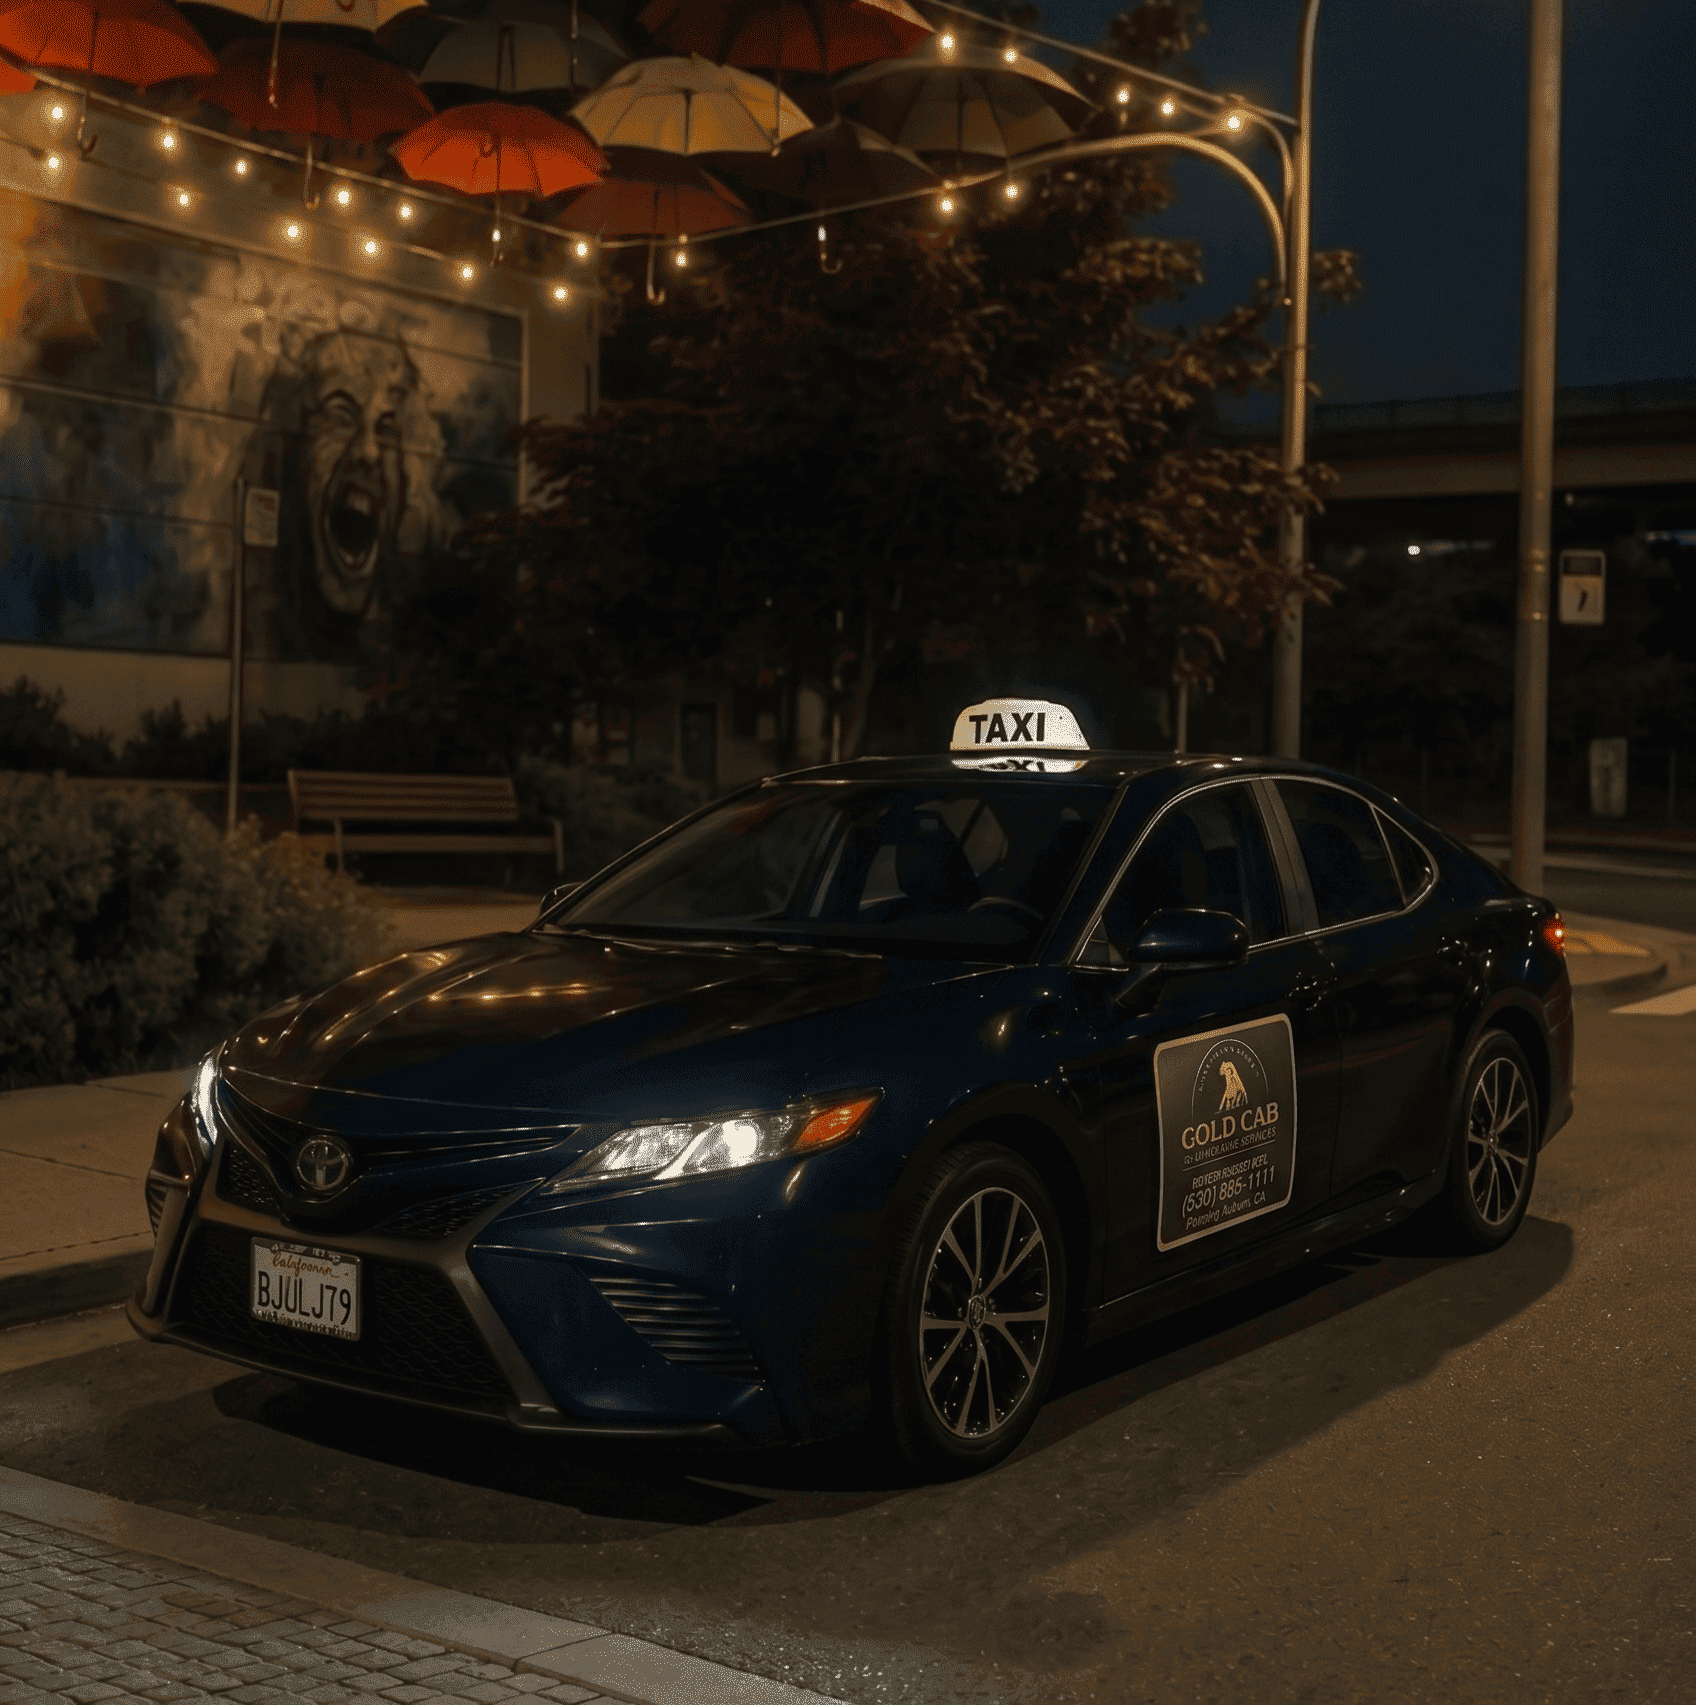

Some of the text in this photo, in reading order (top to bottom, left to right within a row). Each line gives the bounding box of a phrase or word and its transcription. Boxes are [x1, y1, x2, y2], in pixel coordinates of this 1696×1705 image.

[969, 712, 1045, 744] TAXI
[1181, 1102, 1279, 1150] GOLD CAB
[1254, 1190, 1267, 1205] CA
[257, 1270, 352, 1326] BJULJ79
